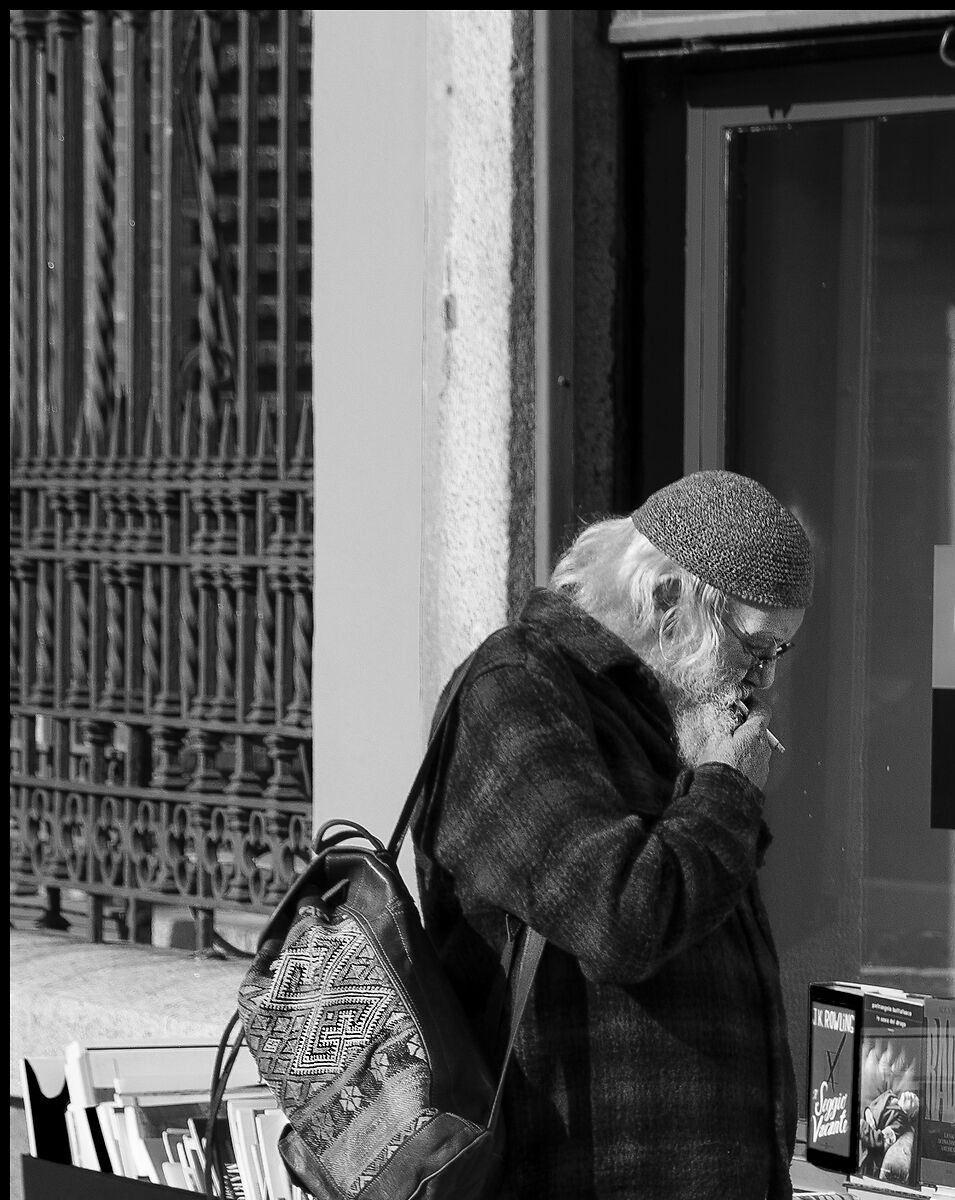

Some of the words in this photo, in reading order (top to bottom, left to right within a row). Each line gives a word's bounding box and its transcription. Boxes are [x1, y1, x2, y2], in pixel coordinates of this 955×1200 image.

[824, 1009, 855, 1034] ROWLING
[815, 1081, 848, 1122] Seggio
[812, 1109, 848, 1143] Vacante
